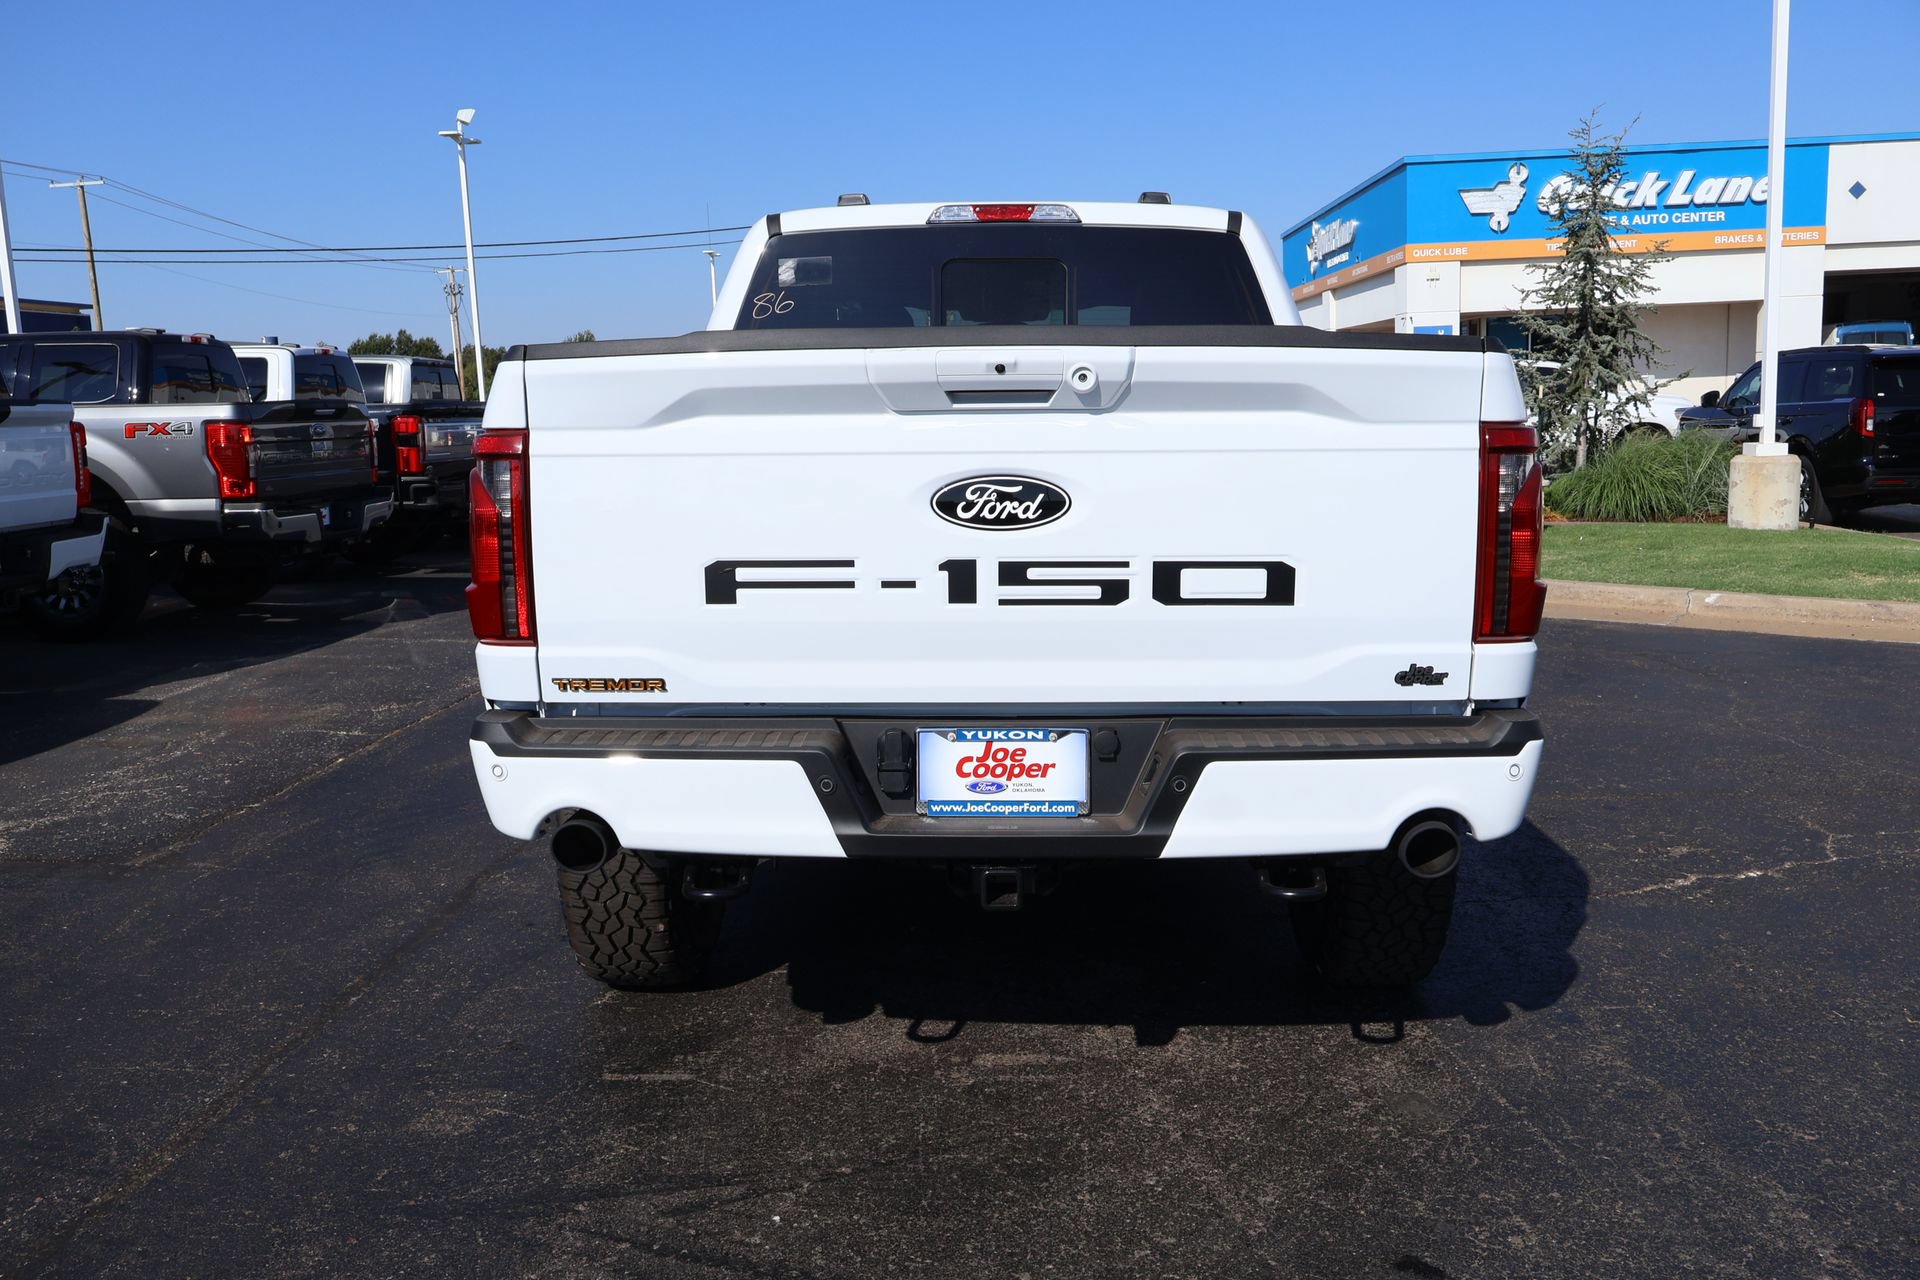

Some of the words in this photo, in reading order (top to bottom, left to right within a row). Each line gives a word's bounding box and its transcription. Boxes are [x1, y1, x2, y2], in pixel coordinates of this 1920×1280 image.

[1664, 169, 1768, 206] Lane
[1632, 213, 1669, 225] AUTO
[1672, 211, 1725, 224] CENTER
[1714, 234, 1754, 244] BRAKES
[1756, 234, 1763, 243] &
[1781, 231, 1820, 241] TTERIES
[1413, 248, 1441, 257] QUICK
[1444, 247, 1469, 256] LUBE
[752, 290, 795, 319] 86
[124, 421, 194, 439] FX4
[956, 483, 1042, 520] Ford
[704, 558, 1296, 606] F-150
[552, 678, 668, 692] TREMOR
[962, 730, 1044, 740] YUKON
[976, 741, 1027, 763] Joe
[955, 756, 1056, 781] Cooper
[976, 781, 997, 792] Ford
[931, 802, 1075, 815] www.JoeCooperFord.com
